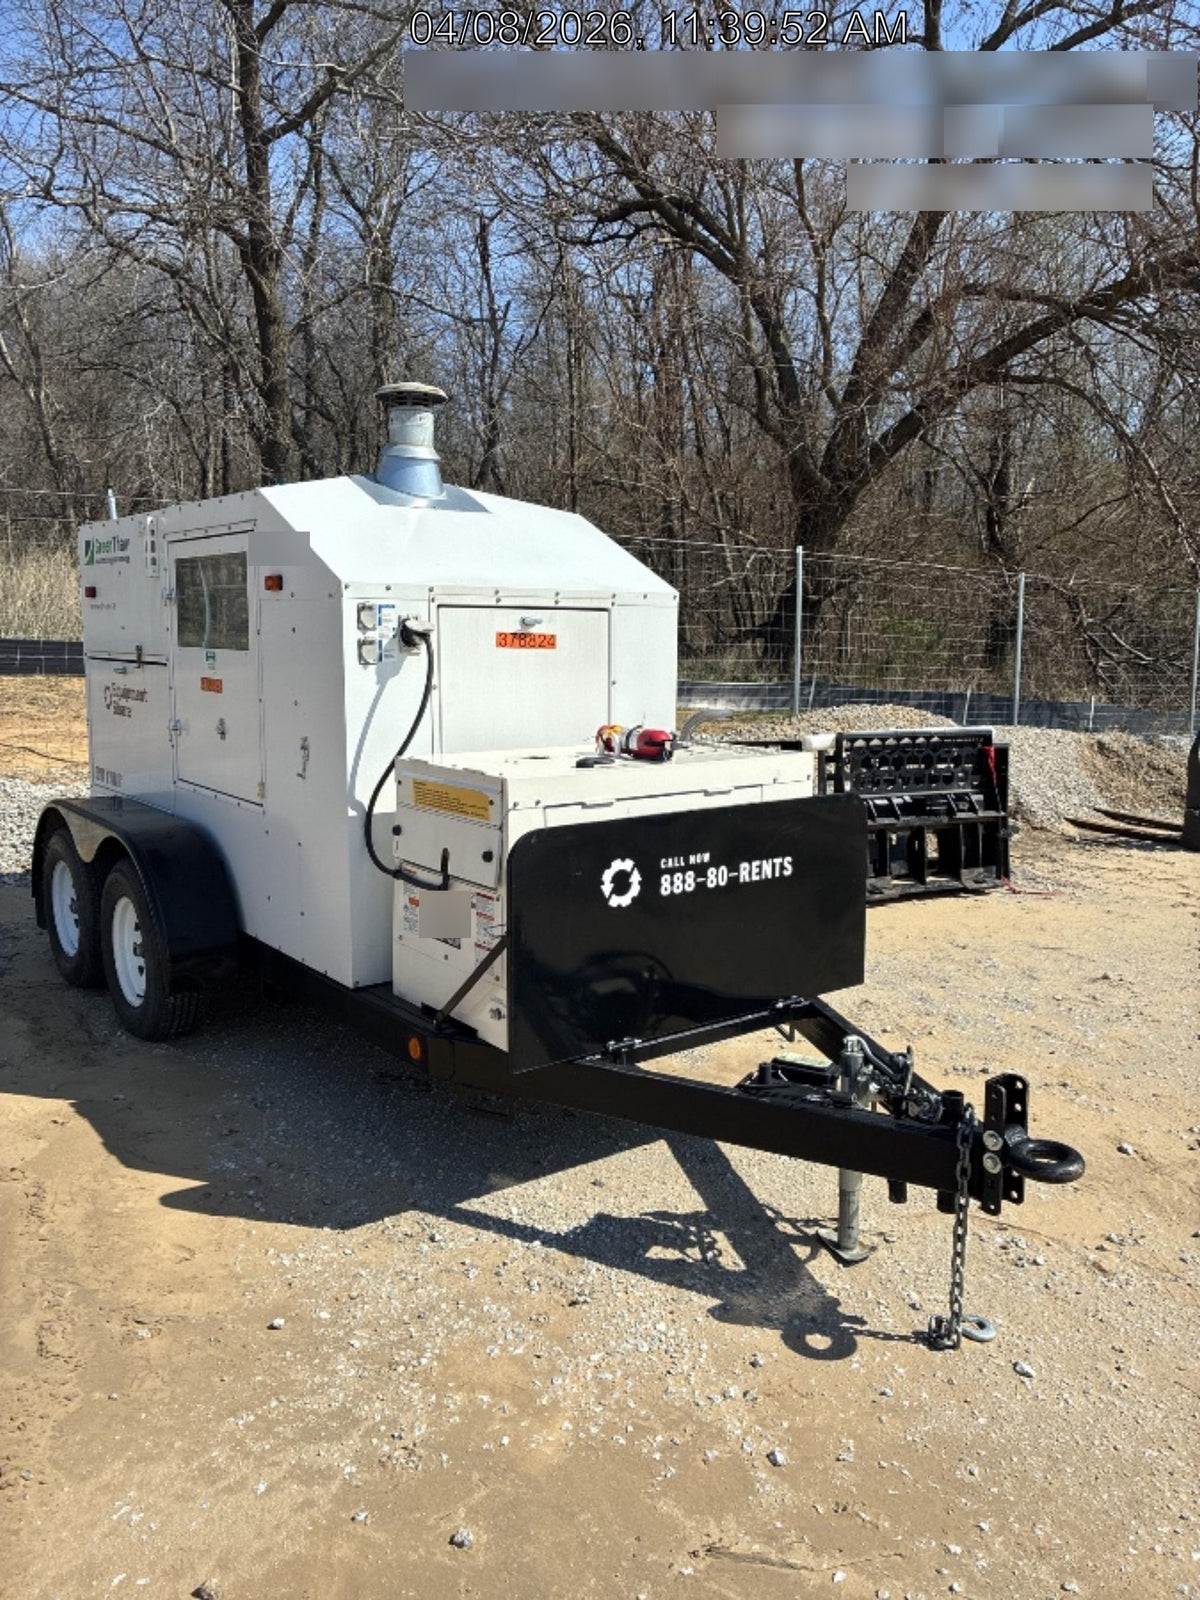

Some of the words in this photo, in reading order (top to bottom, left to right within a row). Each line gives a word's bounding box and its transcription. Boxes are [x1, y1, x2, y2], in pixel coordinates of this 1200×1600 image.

[660, 857, 685, 869] CALL
[689, 852, 710, 865] NOW
[660, 856, 793, 896] 888-80-RENTS
